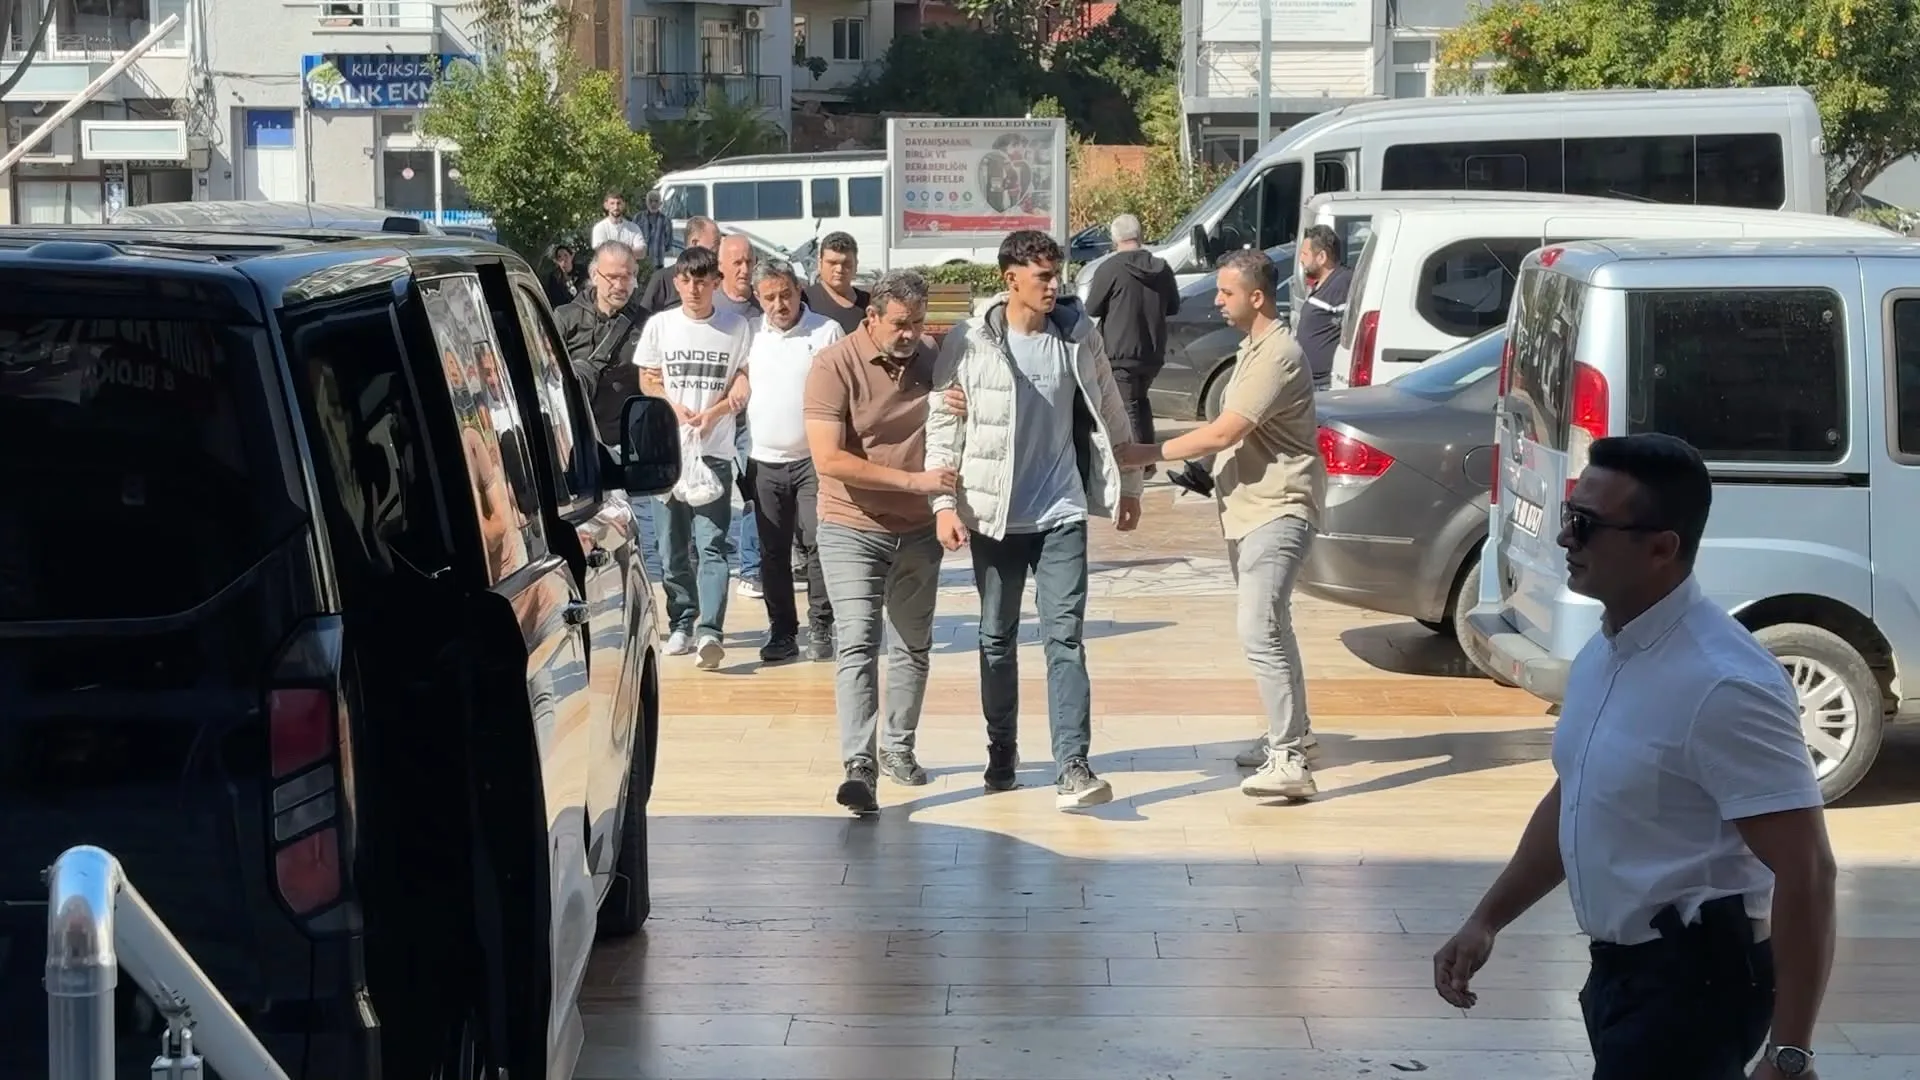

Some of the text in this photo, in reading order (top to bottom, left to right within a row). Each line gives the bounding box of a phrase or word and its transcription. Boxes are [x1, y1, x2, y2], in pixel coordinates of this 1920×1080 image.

[352, 63, 430, 81] KILÇIKSIZ
[312, 81, 434, 104] BALIK EKM
[983, 119, 1052, 128] BELEDİYESİ
[905, 148, 947, 158] BİRLİK VE
[933, 175, 964, 183] EFELER
[665, 351, 730, 363] UNDER
[670, 381, 725, 391] ARMOUR
